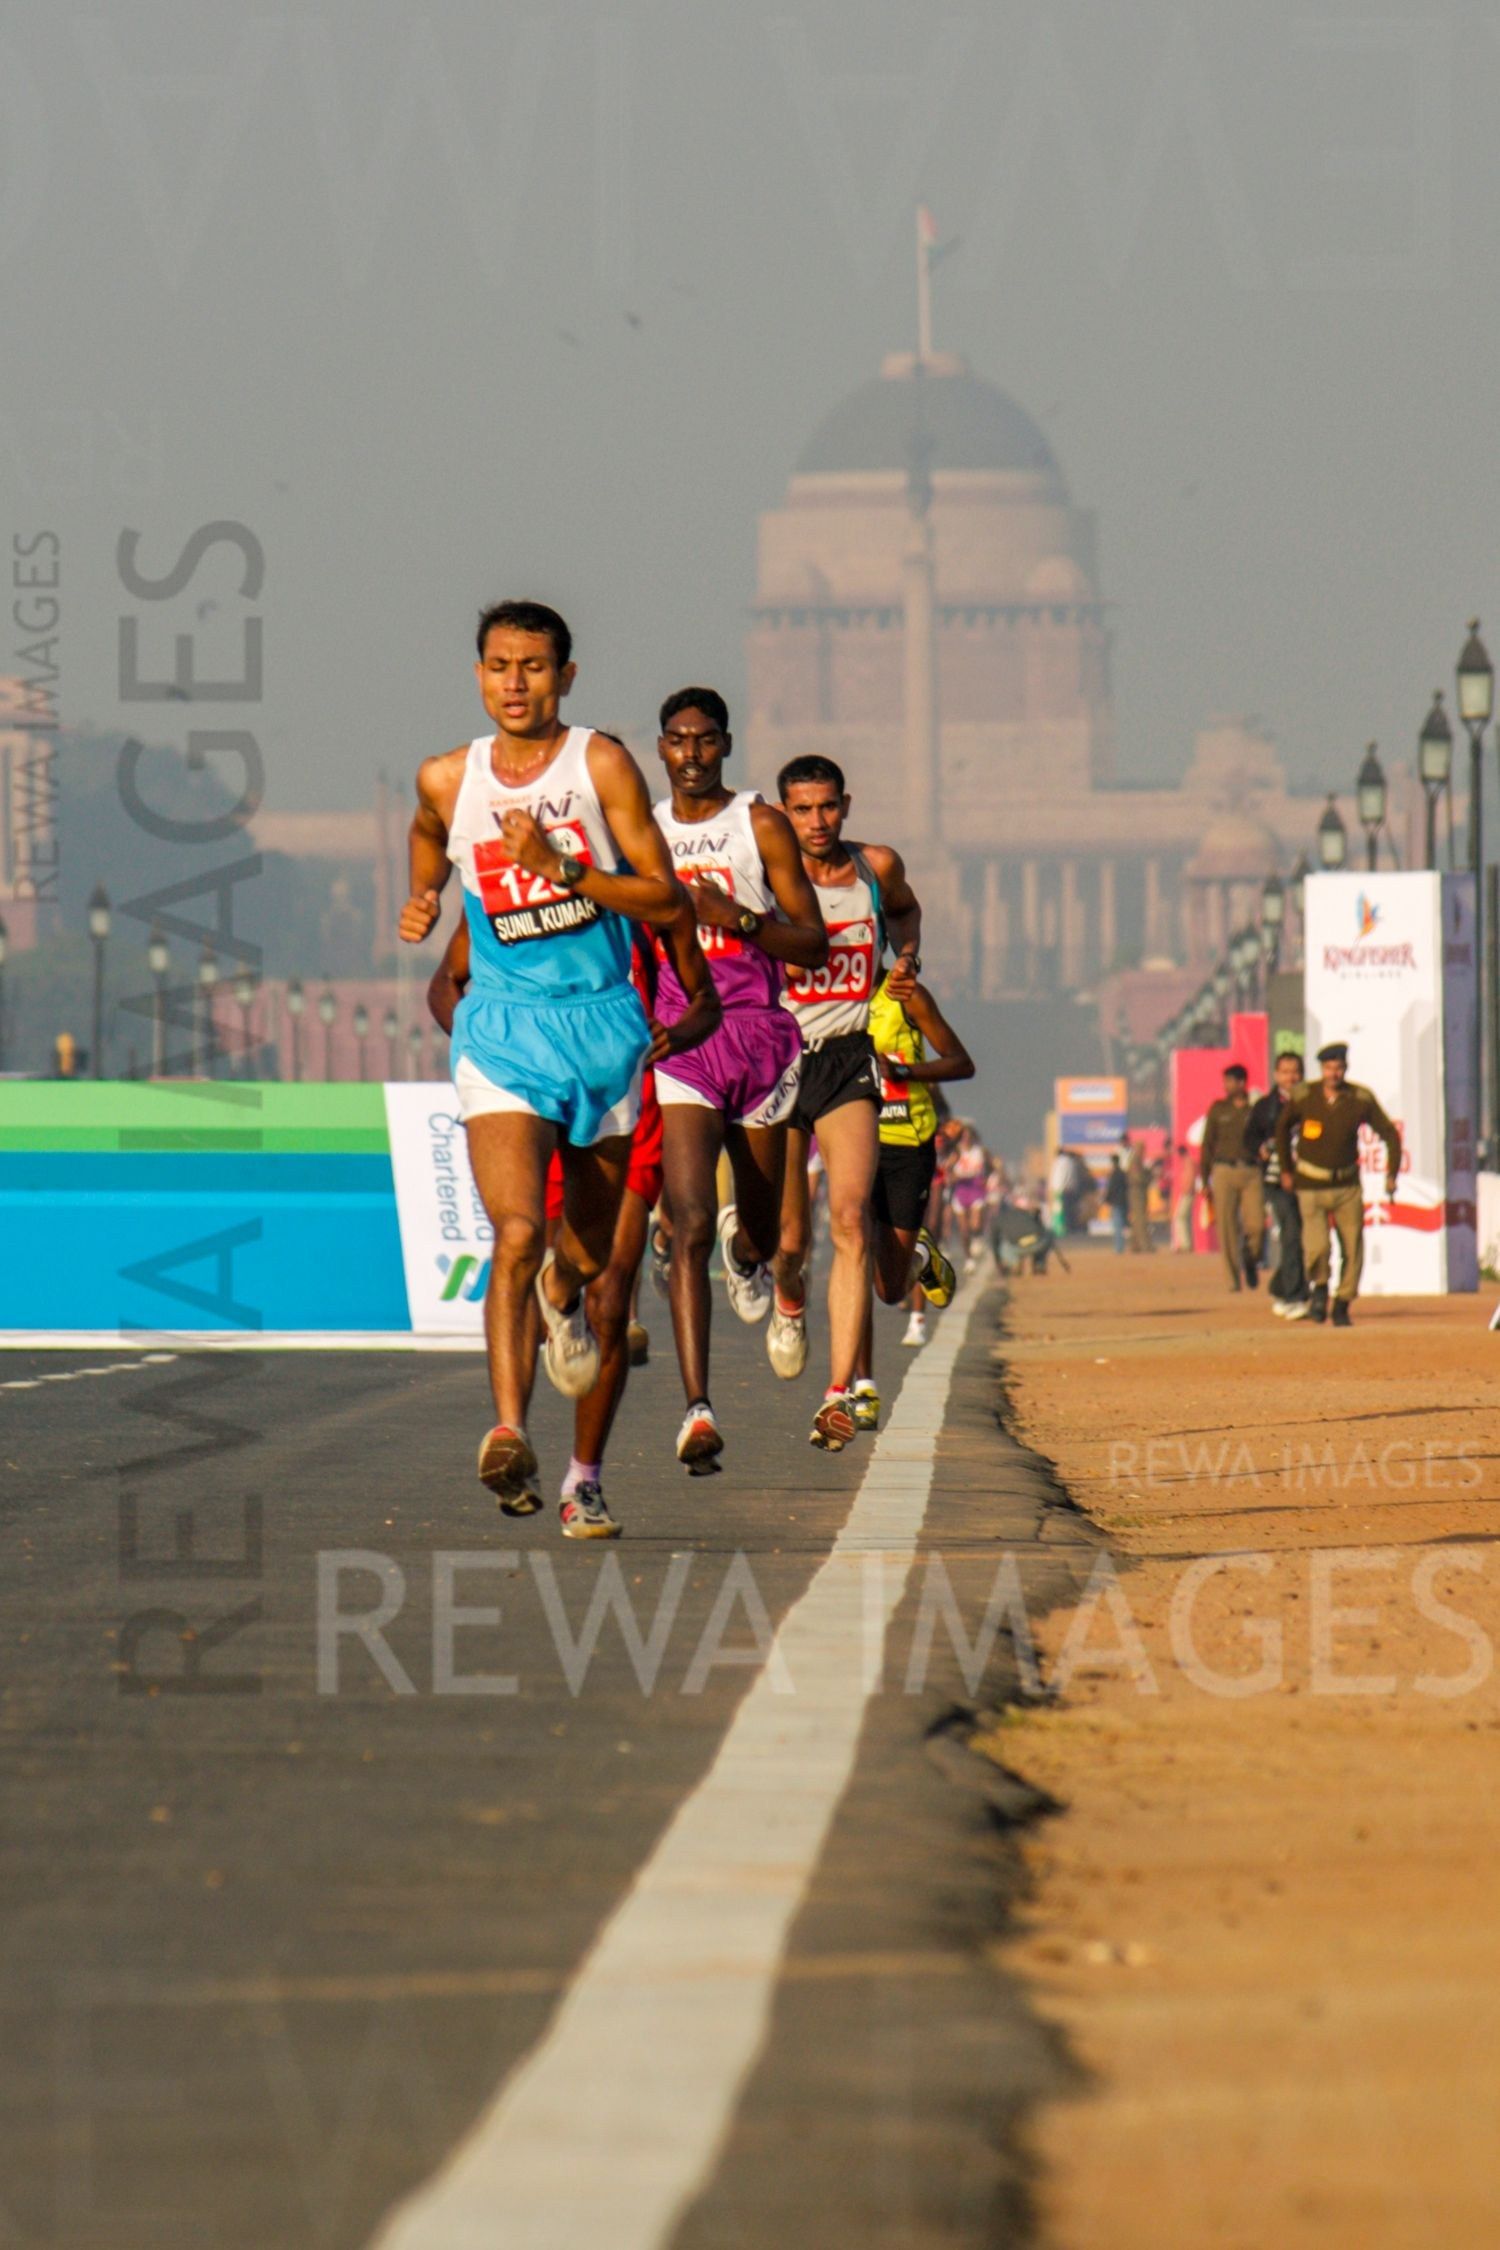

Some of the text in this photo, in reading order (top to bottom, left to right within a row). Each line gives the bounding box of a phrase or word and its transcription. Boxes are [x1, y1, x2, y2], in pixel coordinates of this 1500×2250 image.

[494, 897, 598, 941] SUNIL KUMAR
[429, 1112, 467, 1241] Chartered
